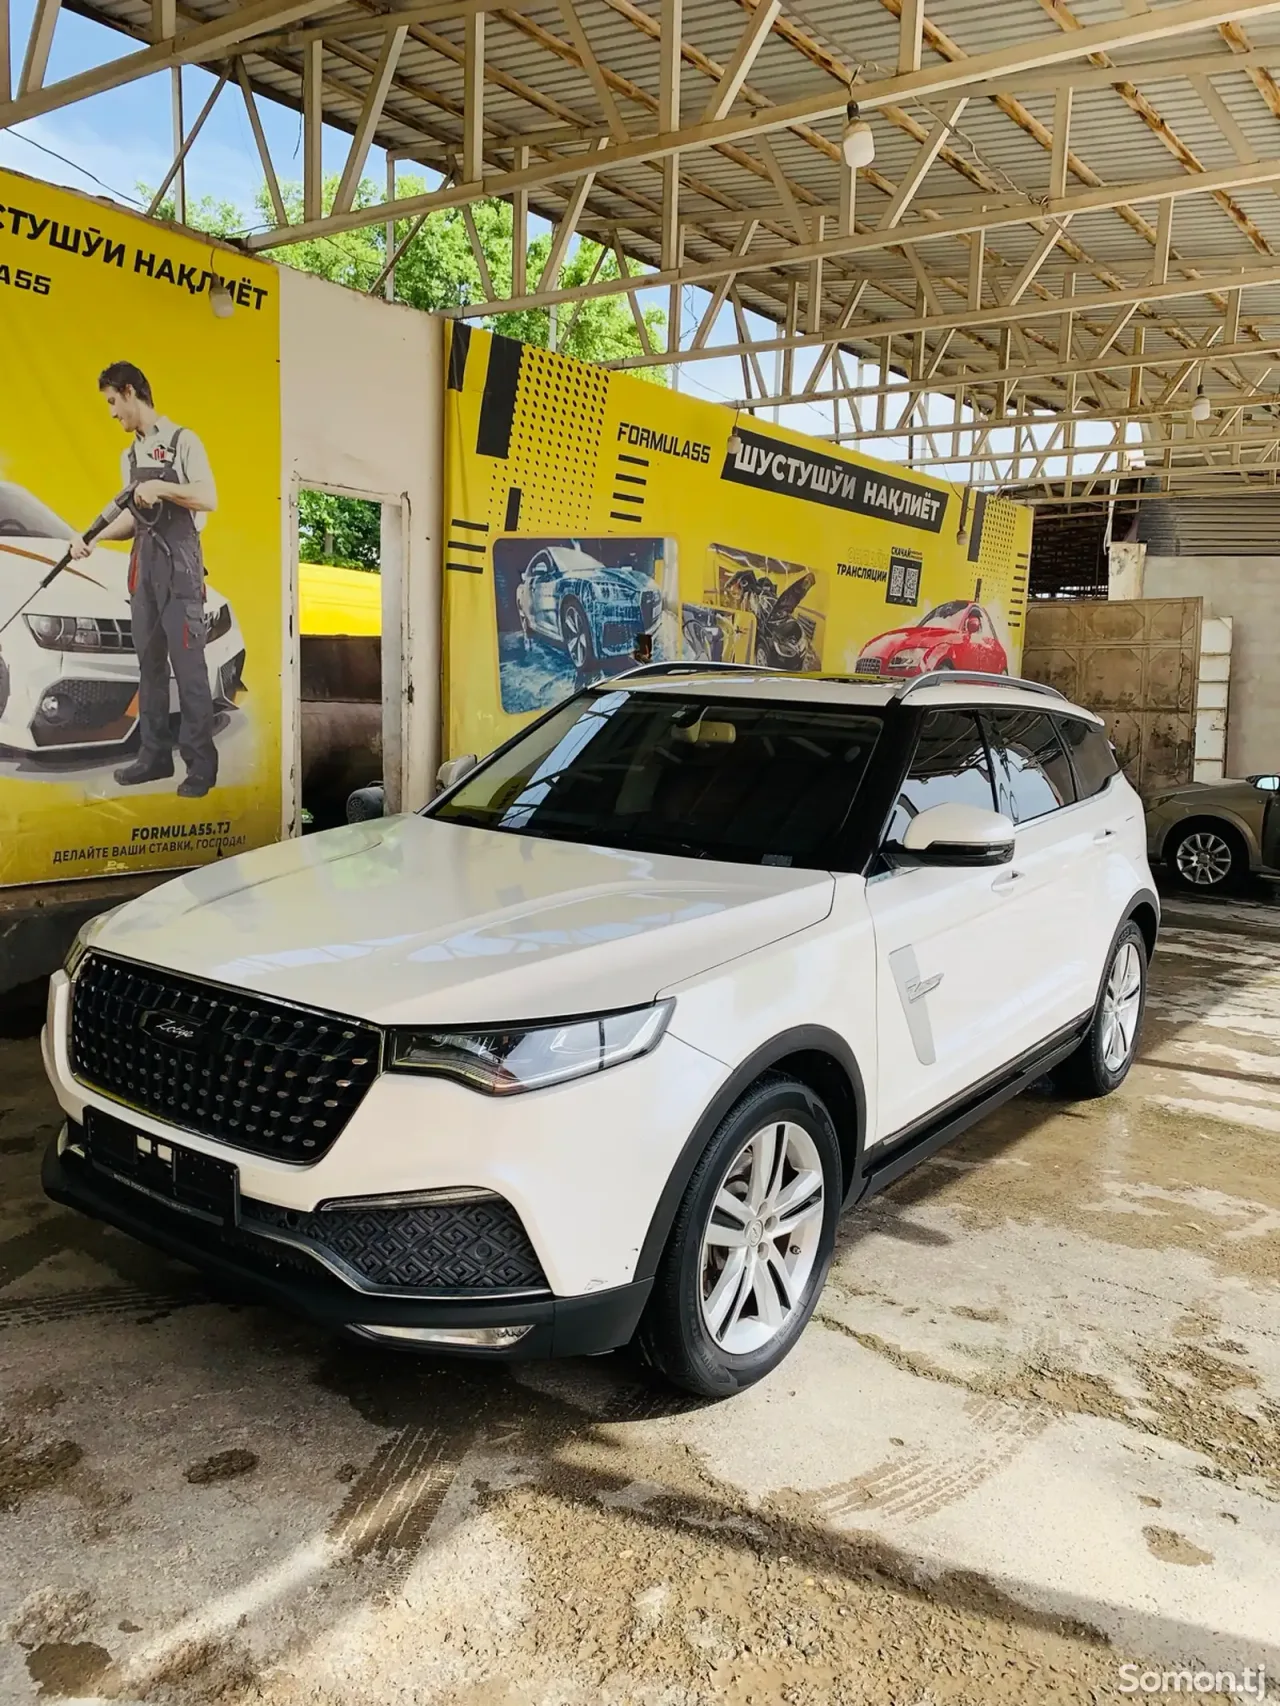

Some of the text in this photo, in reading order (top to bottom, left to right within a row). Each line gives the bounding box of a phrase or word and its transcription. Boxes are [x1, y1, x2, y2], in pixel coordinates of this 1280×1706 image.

[617, 422, 711, 463] FORMULA55
[837, 563, 888, 583] ТРАНСЛЯЦИИ
[131, 821, 231, 841] FORMULA55.TJ
[53, 835, 246, 864] ДЕЛАЙТЕ ВАШИ СТАВКИ, ГОСПОДА!
